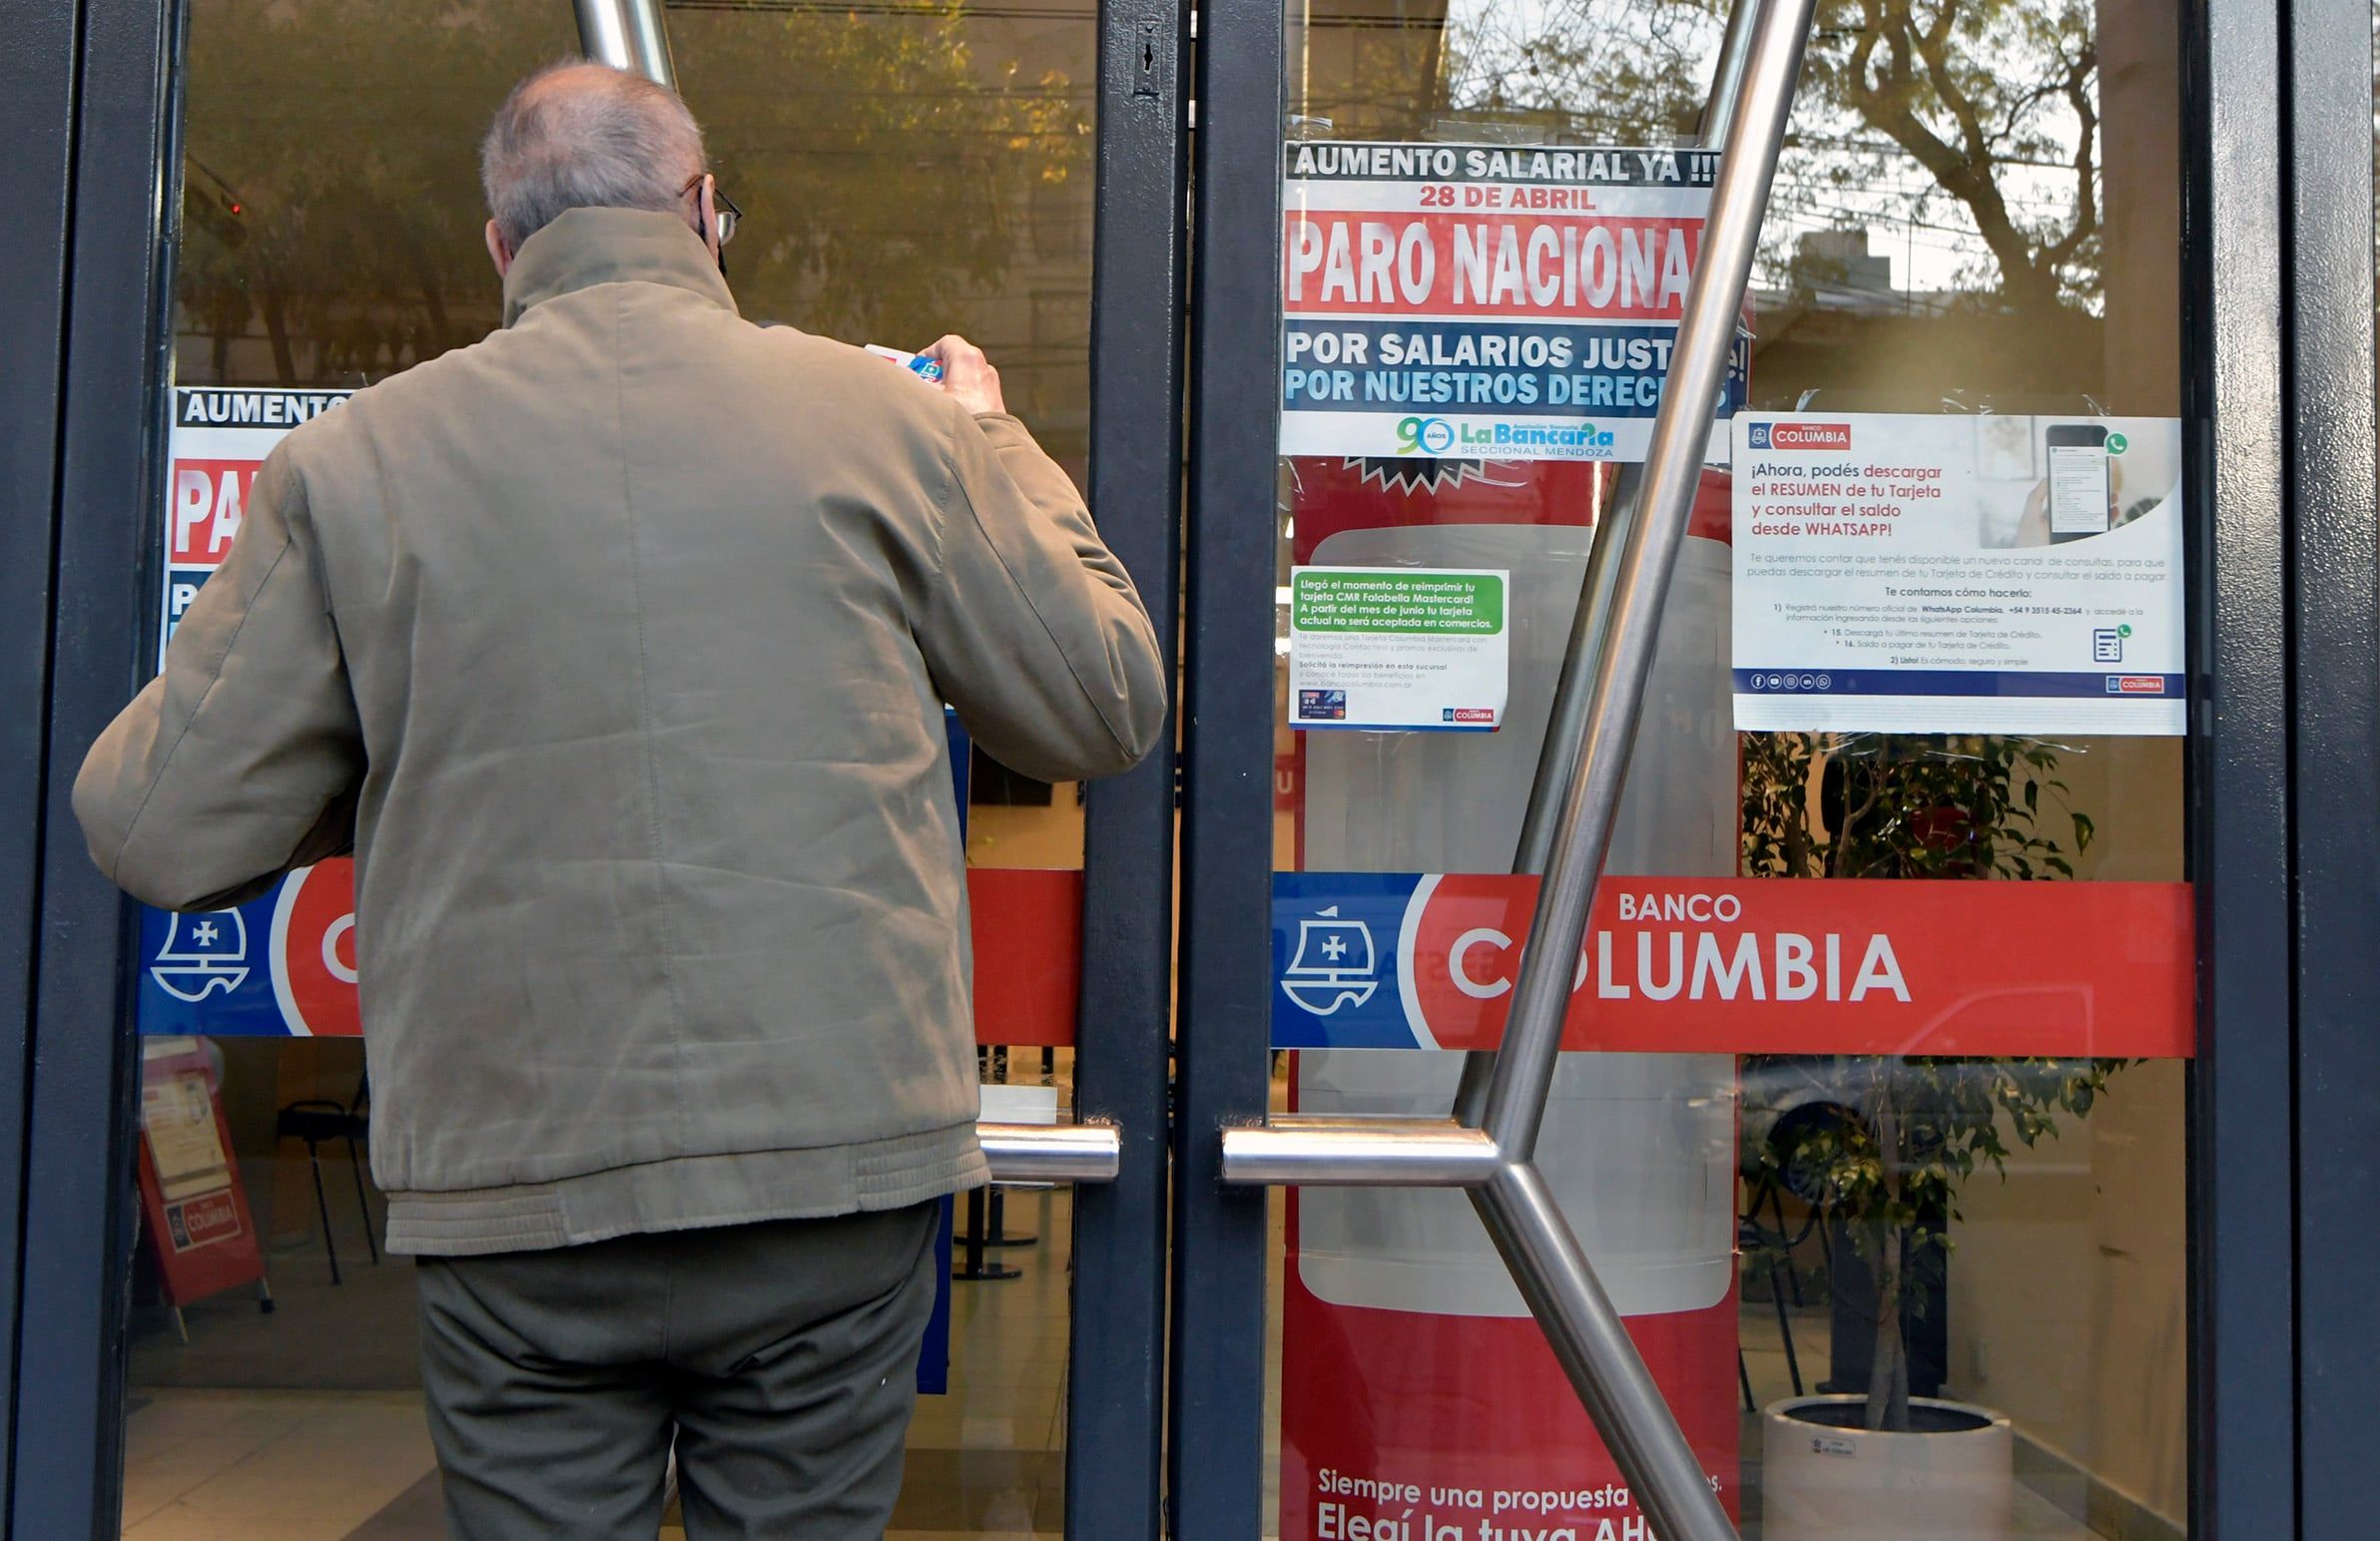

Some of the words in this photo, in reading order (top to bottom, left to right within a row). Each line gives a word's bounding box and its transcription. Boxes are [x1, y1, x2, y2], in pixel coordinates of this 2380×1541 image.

[1294, 148, 1456, 178] AUMENTO
[1465, 150, 1629, 181] SALARIAL
[1636, 152, 1681, 182] YA
[1420, 186, 1456, 208] 28
[1465, 187, 1503, 208] DE
[1509, 188, 1596, 211] ABRIL
[1288, 221, 1436, 304] PARO
[1453, 223, 1706, 309] NACIONA
[1286, 331, 1368, 365] POR
[1379, 333, 1573, 369] SALARIOS
[1582, 337, 1675, 371] JUST
[1285, 369, 1354, 401] POR
[1365, 371, 1538, 406] NUESTROS
[1548, 376, 1726, 409] DEREC
[184, 393, 348, 423] AUMENT
[1776, 430, 1847, 444] COLUMBIA
[1461, 446, 1539, 456] SECCIONAL
[1545, 447, 1614, 457] MENDOZA
[1751, 463, 1807, 479] ¡Ahora,
[1811, 463, 1859, 479] podés
[1864, 465, 1942, 481] descargar
[1751, 483, 1765, 496] el
[1771, 483, 1841, 497] RESUMEN
[1847, 483, 1867, 497] de
[1871, 484, 1885, 497] tu
[1889, 484, 1941, 501] Tarjeta
[175, 469, 257, 554] PA
[1751, 505, 1761, 518] y
[1765, 503, 1837, 517] consultar
[1841, 503, 1855, 516] el
[1859, 503, 1901, 517] saldo
[1751, 523, 1801, 536] desde
[1805, 523, 1892, 536] WHATSAPP!
[1751, 553, 1762, 563] Te
[1765, 555, 1817, 567] queremos
[1820, 555, 1853, 565] contar
[1856, 557, 1875, 567] que
[1879, 554, 1906, 565] tenés
[1909, 555, 1961, 567] disponible
[1979, 557, 2011, 567] nuevo
[2013, 557, 2043, 567] canal
[2049, 557, 2063, 567] de
[2065, 557, 2114, 568] consultas,
[2117, 560, 2141, 569] para
[2144, 560, 2164, 570] que
[1747, 567, 1787, 579] puedas
[1789, 567, 1842, 579] descargar
[1845, 567, 1854, 578] el
[1856, 569, 1899, 579] resumen
[1902, 569, 1916, 579] de
[1919, 569, 1929, 579] tu
[1931, 569, 1966, 581] Tarjeta
[1969, 569, 1983, 580] de
[1985, 569, 2023, 581] Crédito
[2025, 572, 2033, 581] y
[2035, 570, 2079, 581] consultar
[2082, 571, 2092, 581] el
[2094, 571, 2121, 582] saldo
[2124, 573, 2132, 582] a
[1300, 579, 1328, 591] Llegó
[1344, 581, 1392, 591] momento
[1396, 581, 1410, 591] de
[1412, 582, 1463, 593] reimprimir
[1466, 583, 1476, 592] tu
[1885, 587, 1897, 597] Te
[1900, 588, 1953, 598] contamos
[1955, 587, 1987, 598] cómo
[1989, 589, 2033, 599] hacerlo:
[1300, 592, 1334, 603] tarjeta
[1336, 593, 1360, 602] CMR
[1363, 593, 1410, 603] Falabella
[1300, 603, 1308, 613] A
[1312, 605, 1338, 615] partir
[1340, 605, 1356, 614] del
[1359, 606, 1380, 615] mes
[1383, 605, 1398, 615] de
[1400, 605, 1425, 617] junio
[1428, 607, 1438, 616] tu
[1440, 607, 1473, 617] tarjeta
[1774, 604, 1782, 613] 1)
[1849, 604, 1881, 613] número
[1921, 605, 1963, 615] WhatsApp
[2136, 608, 2143, 617] la
[1300, 617, 1332, 626] actual
[1348, 617, 1370, 627] será
[1372, 618, 1422, 629] aceptada
[1439, 619, 1492, 629] comercios.
[1785, 614, 1834, 623] información
[1836, 615, 1879, 624] ingresando
[1907, 615, 1919, 624] las
[1921, 615, 1958, 625] siguientes
[1895, 629, 1918, 638] último
[1969, 631, 1996, 641] Tarjeta
[1889, 642, 1914, 651] pagar
[1938, 641, 1965, 651] Tarjeta
[1338, 661, 1384, 671] reimpresión
[1969, 659, 1996, 668] seguro
[2004, 659, 2029, 668] simple
[1618, 893, 1741, 922] BANCO
[1449, 927, 1913, 1003] CLUMBIA
[1318, 1468, 1422, 1505] Siempre
[1430, 1486, 1483, 1508] una
[1493, 1483, 1629, 1515] propuesta
[1318, 1501, 1414, 1541] Elegí
